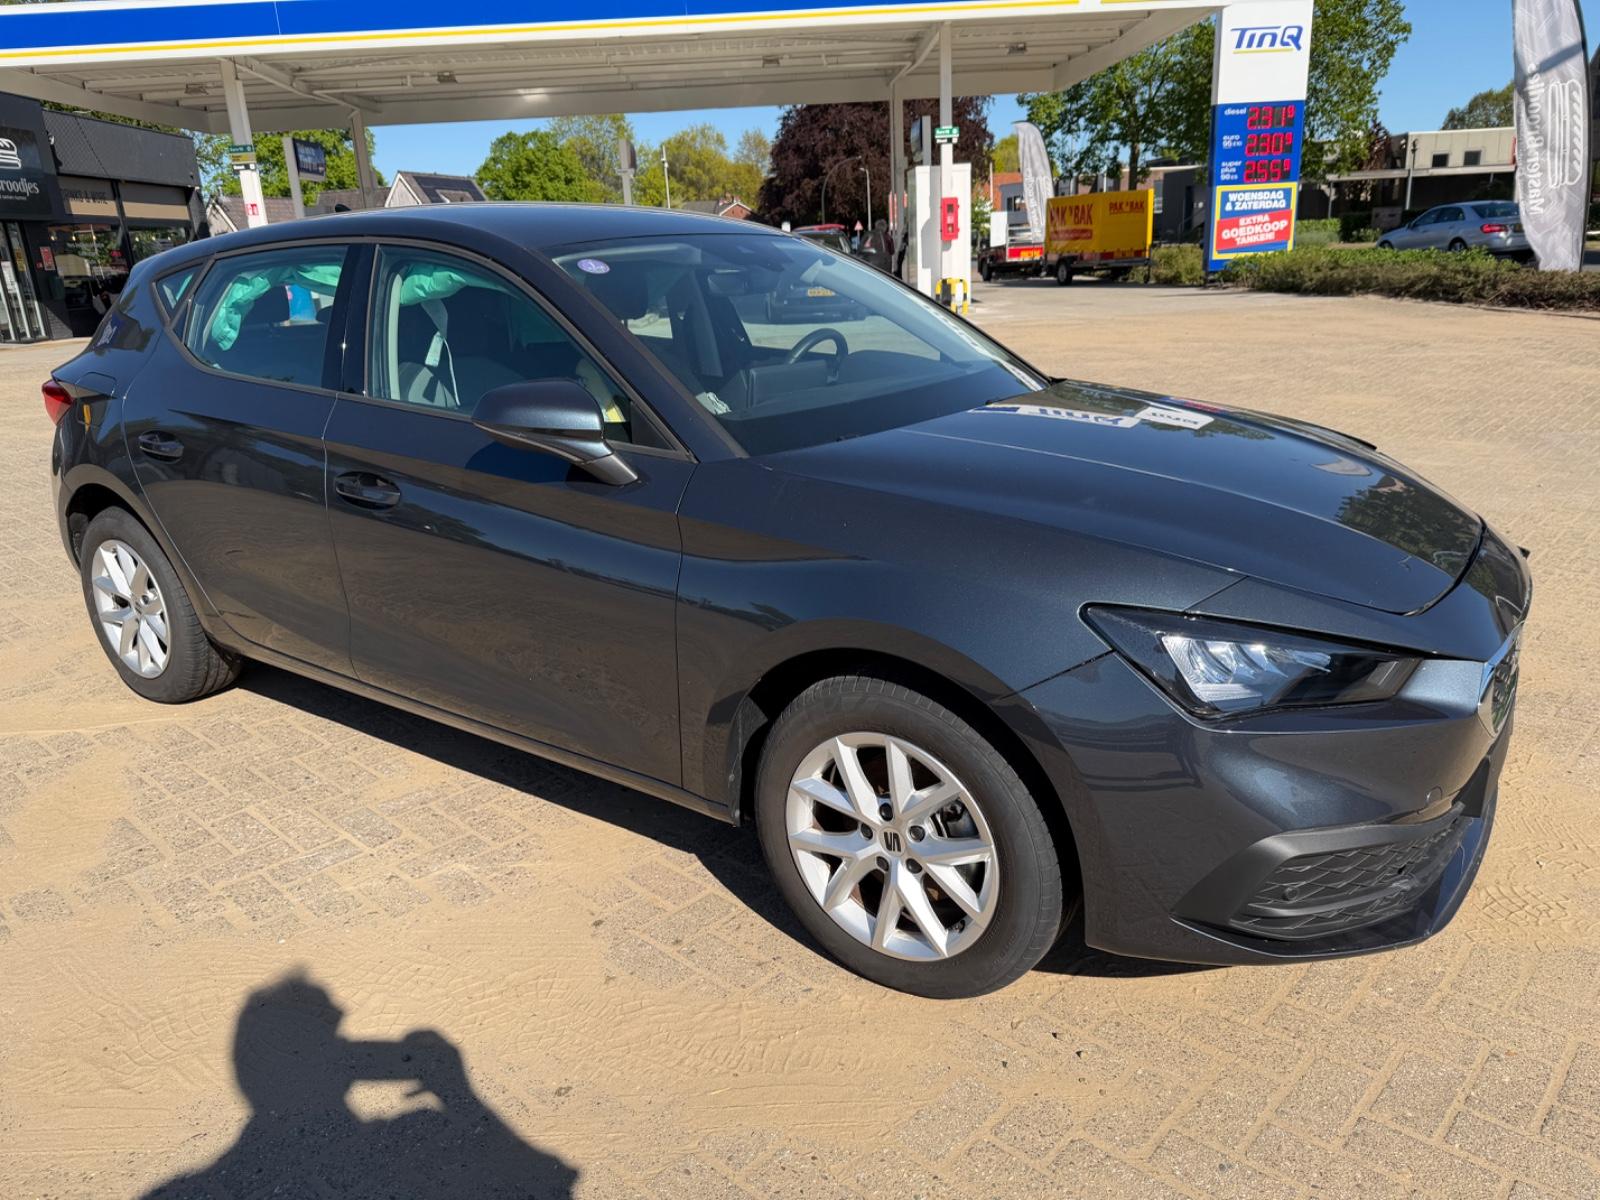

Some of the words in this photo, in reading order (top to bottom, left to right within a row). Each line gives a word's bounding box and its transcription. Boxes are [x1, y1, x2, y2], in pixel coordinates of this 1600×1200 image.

[1230, 25, 1303, 51] TinQ
[1224, 107, 1247, 116] diesel
[1228, 190, 1284, 202] WOENSDAG
[1234, 199, 1286, 211] ZATERDAG
[1239, 214, 1270, 226] EXTRA
[1221, 220, 1288, 239] GOEDKOOP
